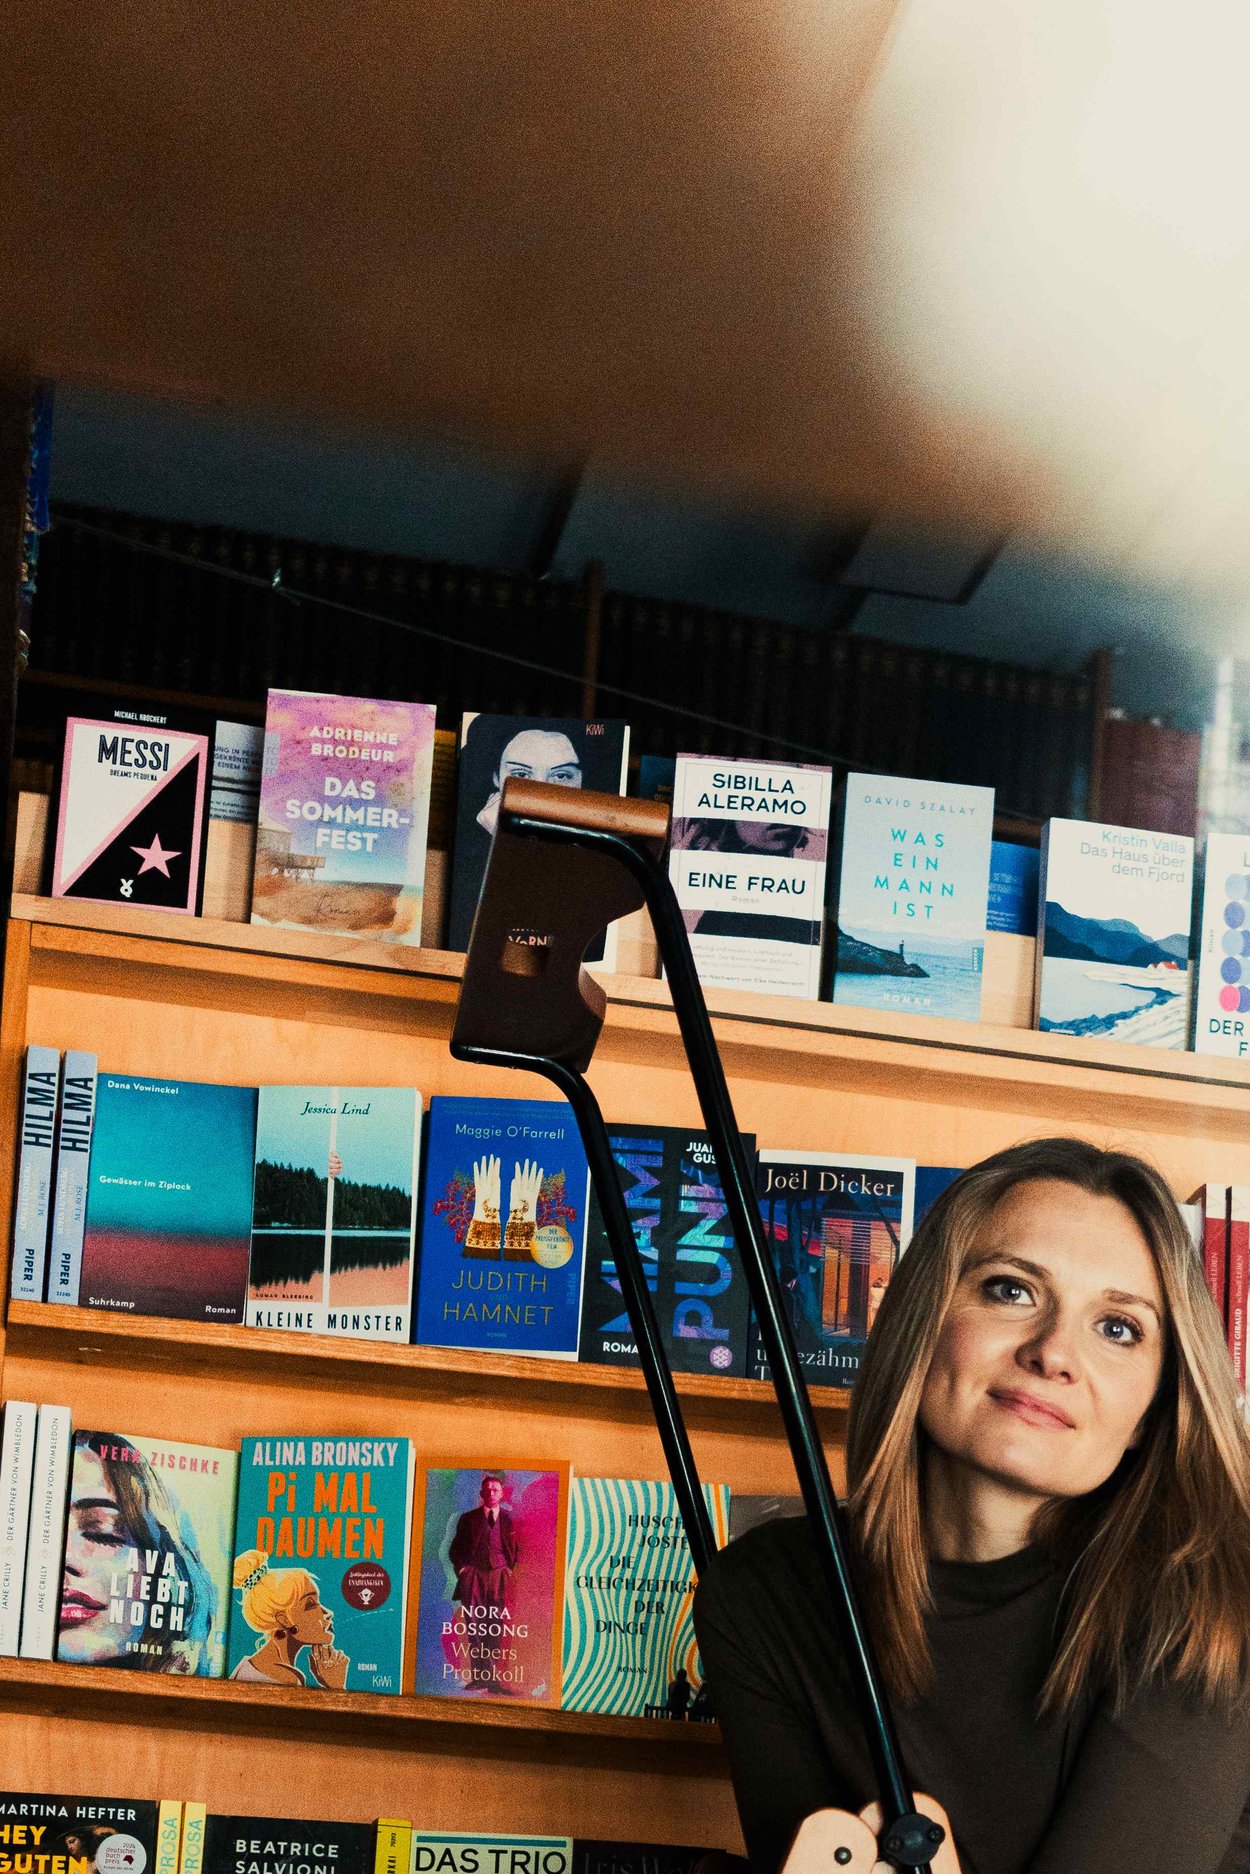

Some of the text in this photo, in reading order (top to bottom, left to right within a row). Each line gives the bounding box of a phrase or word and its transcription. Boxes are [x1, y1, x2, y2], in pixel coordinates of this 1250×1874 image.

[309, 725, 398, 746] ADRIENNE
[97, 734, 170, 772] MESSI
[310, 743, 394, 762] BRODEUR
[110, 768, 132, 779] DREAMS
[712, 772, 795, 794] SIBILLA
[324, 776, 376, 800] DAS
[285, 799, 411, 829] SOMMER-
[698, 793, 807, 816] ALERAMO
[316, 828, 379, 852] FEST
[890, 828, 945, 848] WAS
[893, 853, 938, 872] EIN
[688, 872, 806, 895] EINE FRAU
[874, 875, 954, 897] MANN
[892, 902, 934, 920] IST
[1209, 1018, 1244, 1037] DER
[107, 1080, 180, 1095] Dana Vowinckel
[23, 1072, 56, 1148] HILMA
[60, 1076, 94, 1153] HILMA
[300, 1101, 372, 1116] Jessica Lind
[454, 1123, 502, 1139] Maggie
[100, 1174, 192, 1191] Gewässer im Ziplock
[764, 1168, 896, 1197] Joël Dicker
[23, 1248, 35, 1282] PIPER
[60, 1252, 71, 1286] PIPER
[452, 1270, 548, 1293] JUDITH
[88, 1296, 236, 1314] Suhrkamp Roman
[443, 1302, 554, 1326] HAMNET
[256, 1310, 403, 1332] KLEINE MONSTER
[13, 1414, 23, 1464] WIMBLEDON
[49, 1418, 59, 1466] WIMBLEDON
[99, 1444, 220, 1476] VERA ZISCHKE
[252, 1440, 399, 1468] ALINA BRONSKY
[313, 1471, 377, 1514] MAL
[256, 1516, 384, 1560] DAUMEN
[126, 1547, 176, 1578] AVA
[609, 1555, 636, 1570] DIE
[110, 1573, 190, 1606] LIEBT
[109, 1600, 184, 1632] NOCH
[460, 1605, 512, 1620] NORA
[634, 1600, 666, 1615] DER
[442, 1622, 528, 1638] BOSSONG
[596, 1619, 648, 1636] DINGE
[125, 1641, 163, 1656] ROMAN
[450, 1642, 518, 1660] Webers
[358, 1662, 378, 1672] ROMAN
[442, 1664, 524, 1683] Protokoll
[617, 1665, 648, 1674] ROMAN
[76, 1806, 137, 1822] HEFTER
[105, 1846, 136, 1855] deutscher
[235, 1838, 339, 1858] BEATRICE
[104, 1857, 121, 1866] preis
[414, 1846, 480, 1874] DAS
